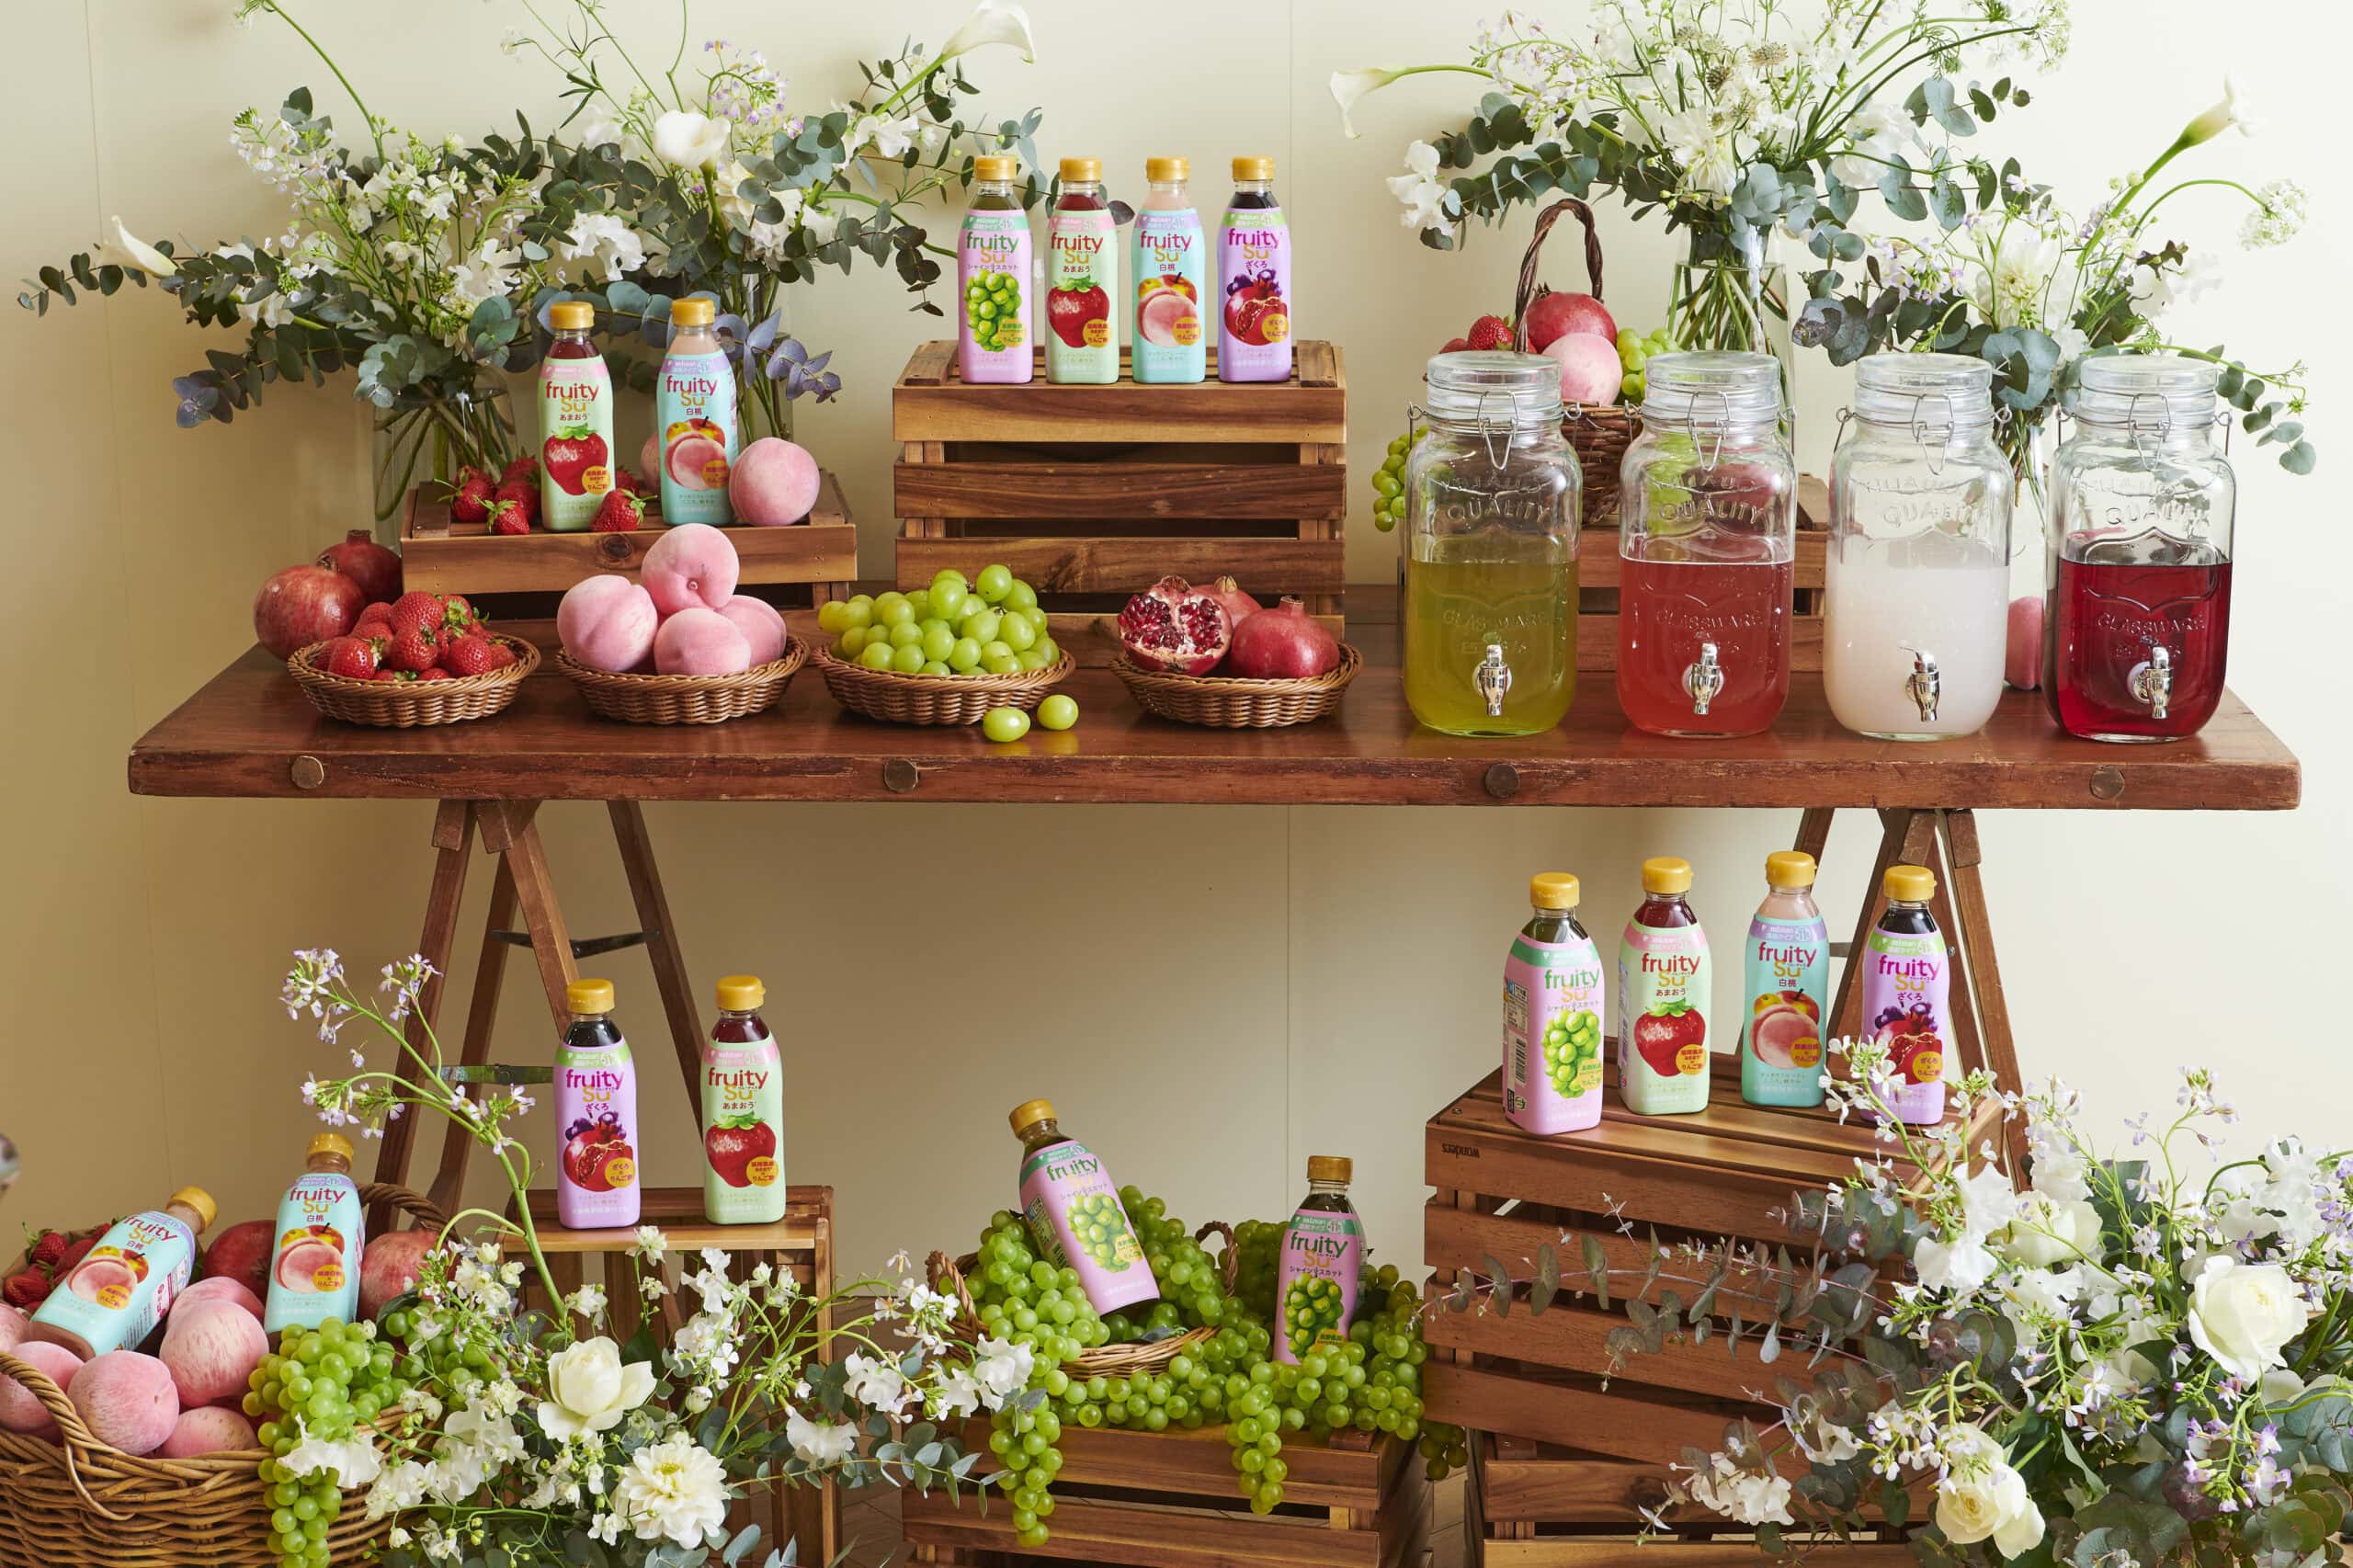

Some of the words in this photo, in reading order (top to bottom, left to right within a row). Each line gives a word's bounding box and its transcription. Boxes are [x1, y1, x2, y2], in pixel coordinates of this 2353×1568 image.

[966, 233, 1018, 253] fruity
[1051, 233, 1103, 255] fruity
[1140, 231, 1192, 252] fruity
[1228, 228, 1279, 249] fruity
[981, 247, 1006, 263] Su
[1063, 247, 1089, 264] Su
[1154, 246, 1179, 262] Su
[1244, 244, 1269, 260] Su
[1245, 260, 1267, 268] ざくろ
[545, 381, 599, 402] fruity
[666, 375, 718, 396] fruity
[561, 396, 586, 413] Su
[680, 391, 706, 406] Su
[1447, 498, 1553, 524] QUALITY
[1660, 499, 1766, 524] QUALITY
[1642, 952, 1700, 974] fruity
[1758, 941, 1817, 967] fruity
[1773, 960, 1801, 978] Su
[1879, 955, 1941, 981] fruity
[1544, 969, 1600, 990] fruity
[1657, 970, 1686, 987] Su
[1894, 974, 1926, 991] Su
[1561, 985, 1587, 1004] Su
[1655, 989, 1687, 997] あまおう
[1897, 992, 1923, 1001] ざくろ
[565, 1069, 625, 1090] fruity
[708, 1067, 769, 1089] fruity
[582, 1085, 611, 1102] Su
[723, 1085, 754, 1101] Su
[585, 1103, 608, 1112] ざくろ
[1047, 1158, 1098, 1181] fruity
[290, 1187, 347, 1203] fruity
[302, 1199, 329, 1213] Su
[123, 1216, 177, 1241] fruity
[128, 1227, 155, 1245] Su
[1290, 1231, 1348, 1258] fruity
[1303, 1249, 1332, 1268] Su
